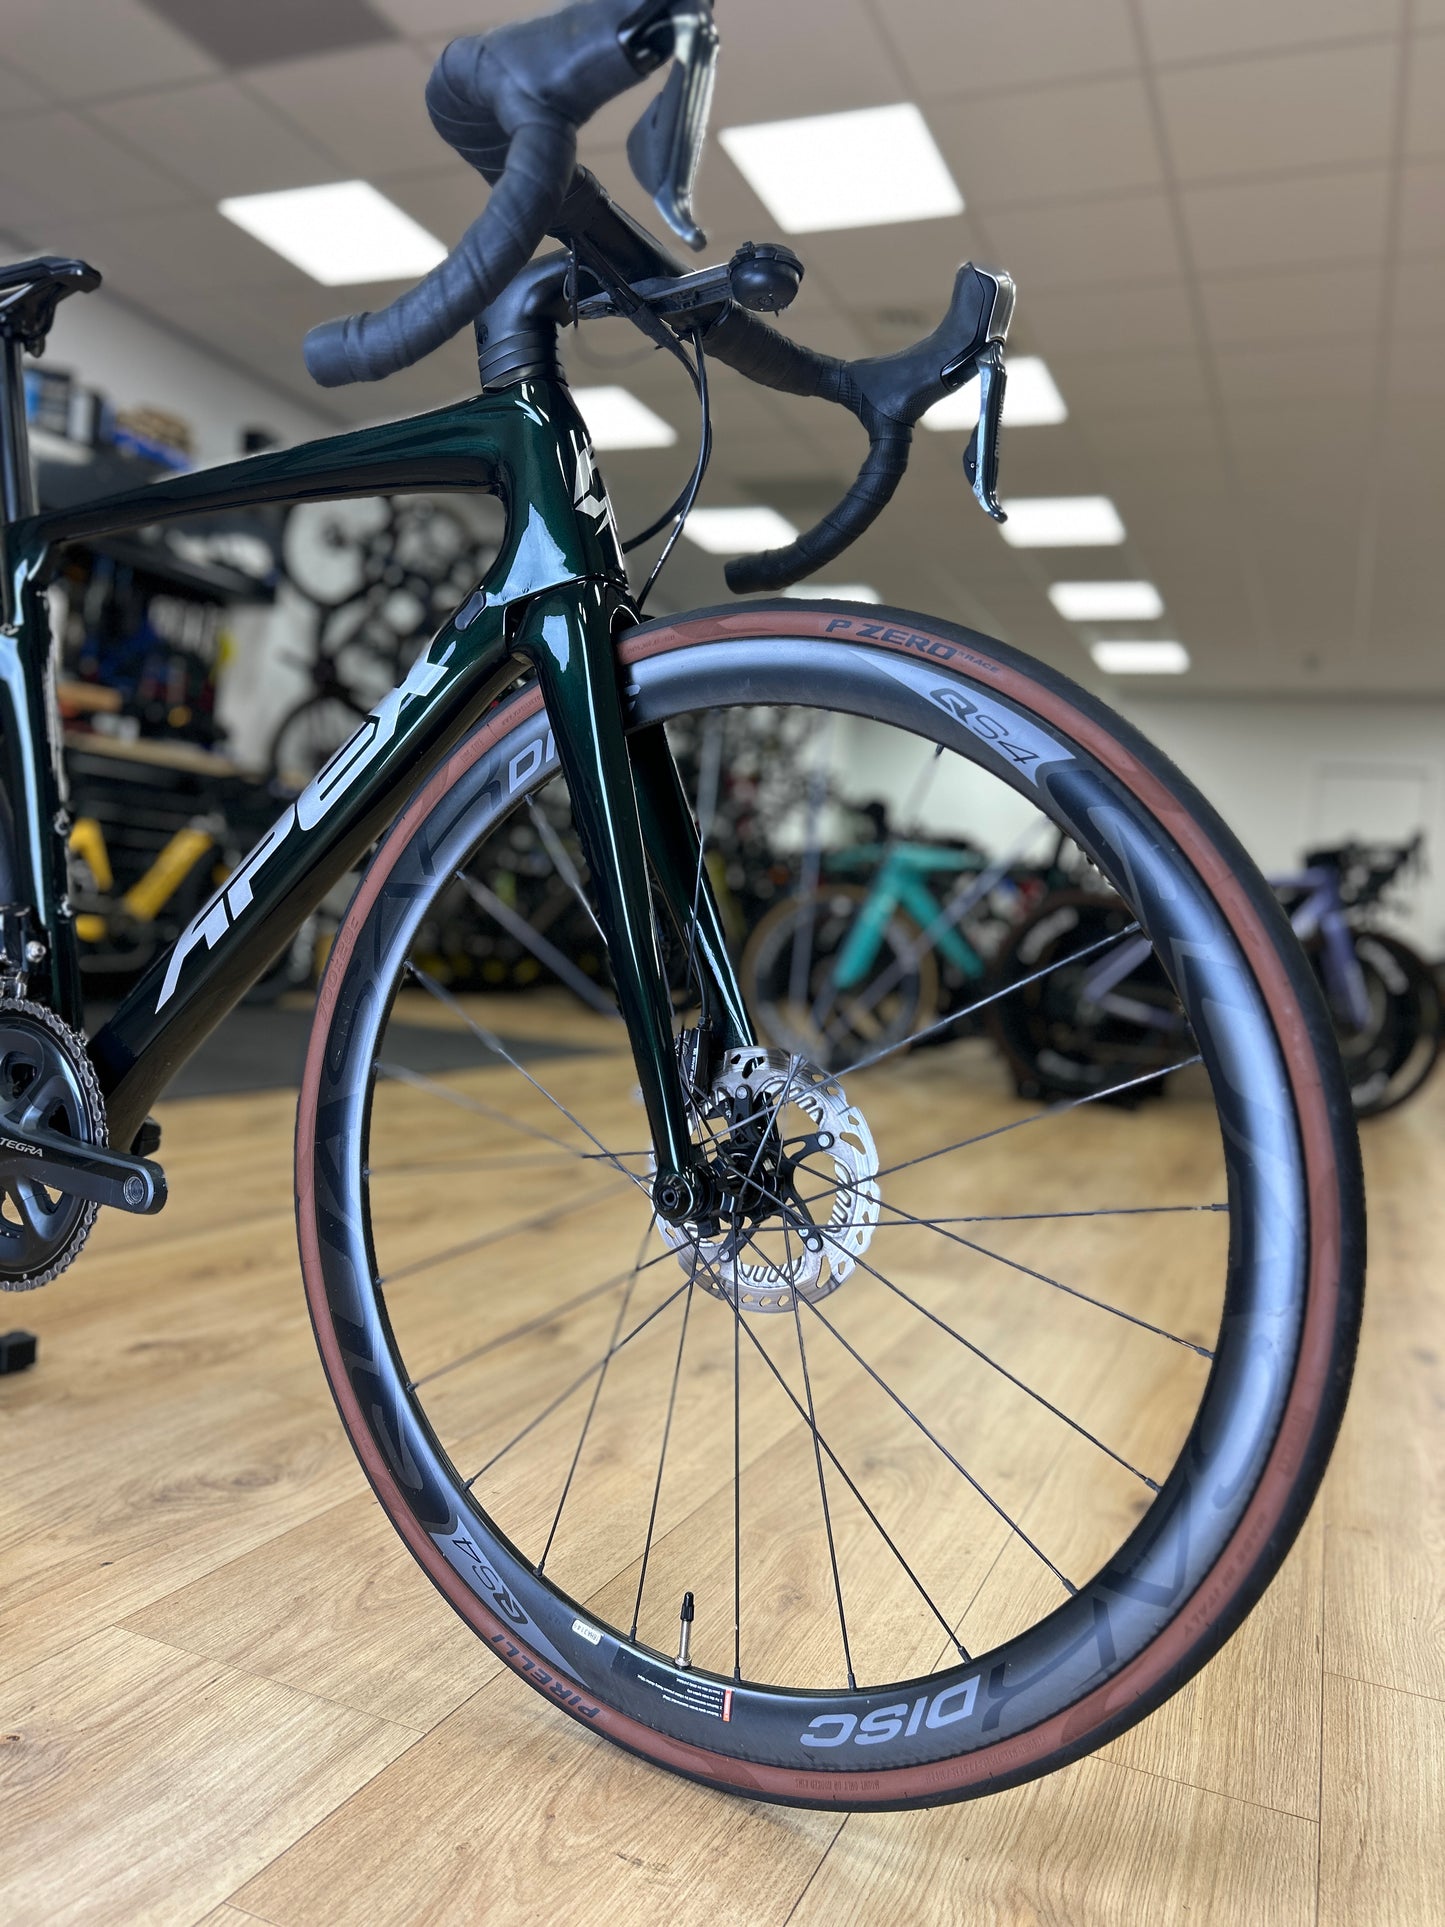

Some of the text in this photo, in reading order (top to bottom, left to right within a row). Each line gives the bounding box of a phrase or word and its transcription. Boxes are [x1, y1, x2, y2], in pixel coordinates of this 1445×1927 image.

[826, 618, 853, 633] P
[855, 622, 958, 661] ZERO
[930, 687, 1040, 766] QS4
[0, 1137, 43, 1158] TEGRA
[451, 1536, 529, 1625] QS4
[489, 1633, 600, 1719] PIRELLI
[800, 1674, 981, 1748] DISC
